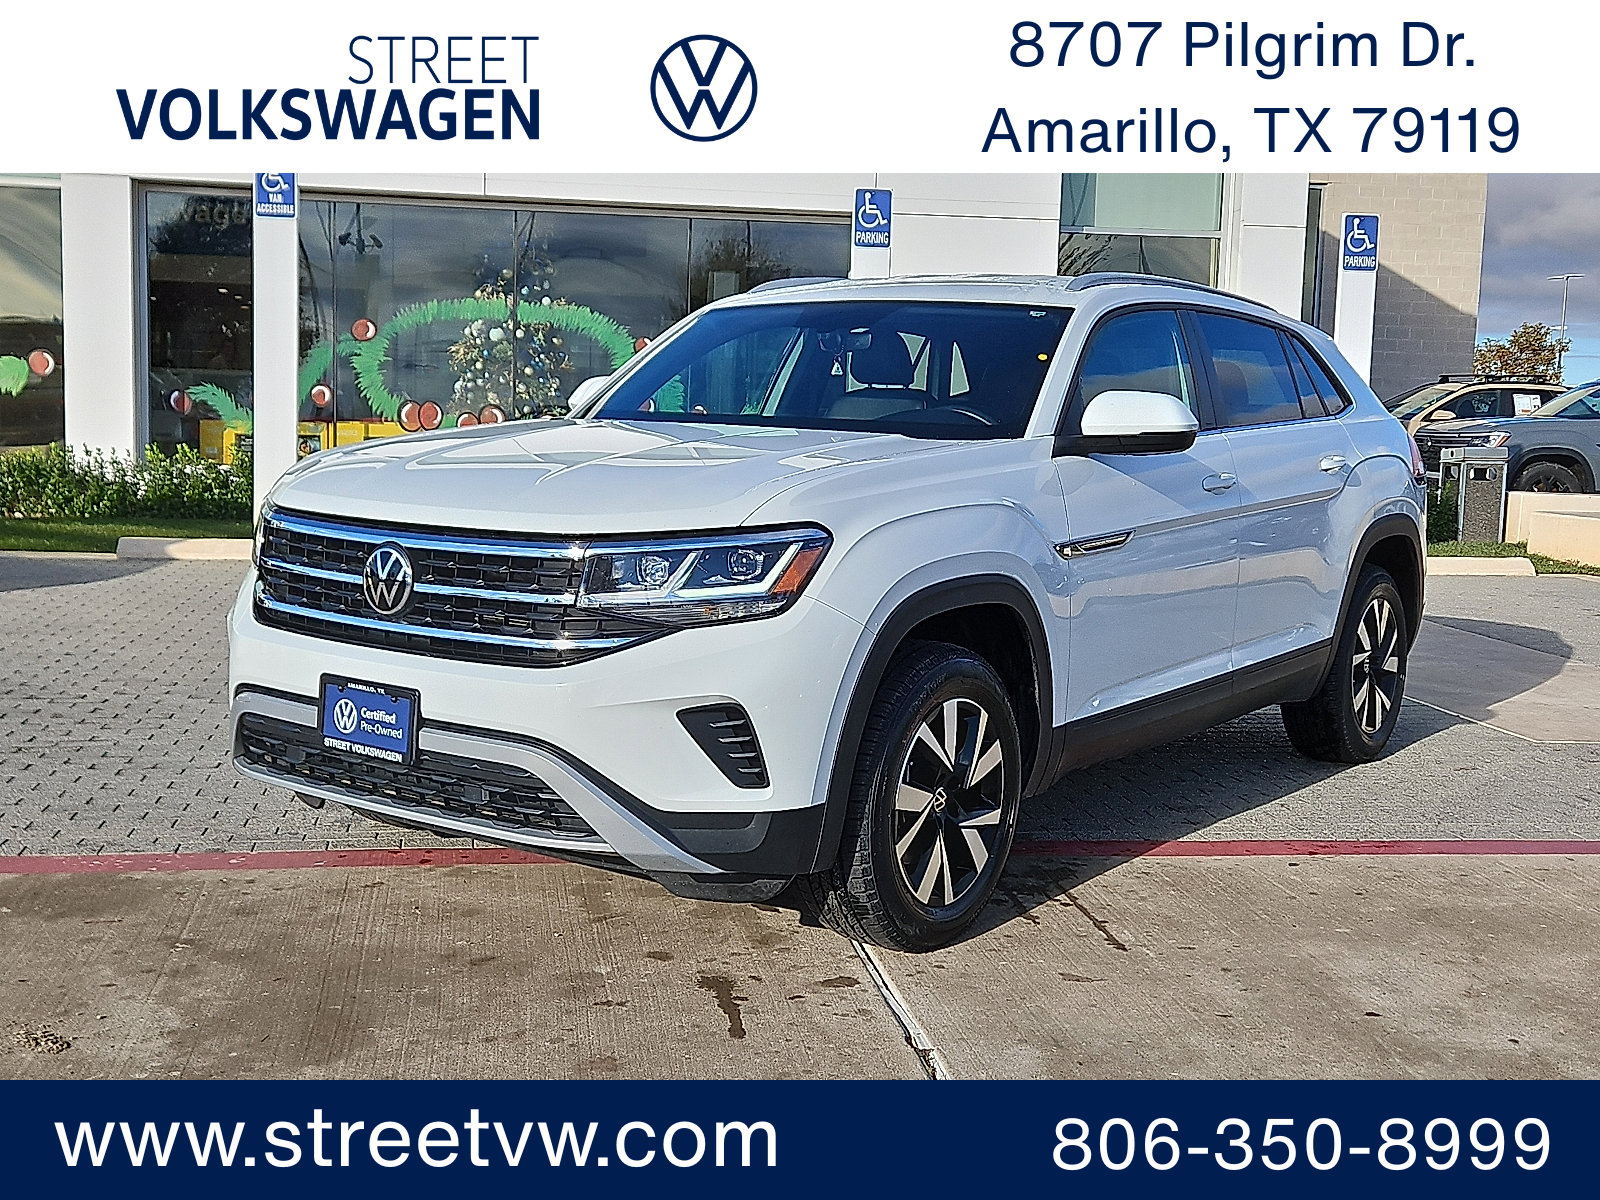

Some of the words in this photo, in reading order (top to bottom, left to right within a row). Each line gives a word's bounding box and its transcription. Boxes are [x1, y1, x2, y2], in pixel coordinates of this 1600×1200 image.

[268, 193, 283, 203] VAN
[256, 203, 295, 214] ACCESSIBLE
[855, 231, 889, 245] PARKING
[1344, 255, 1376, 268] PARKING
[360, 707, 397, 725] Certified
[360, 720, 403, 739] Pre-Owned
[323, 737, 351, 752] STREET
[350, 743, 403, 763] VOLKSWAGEN
